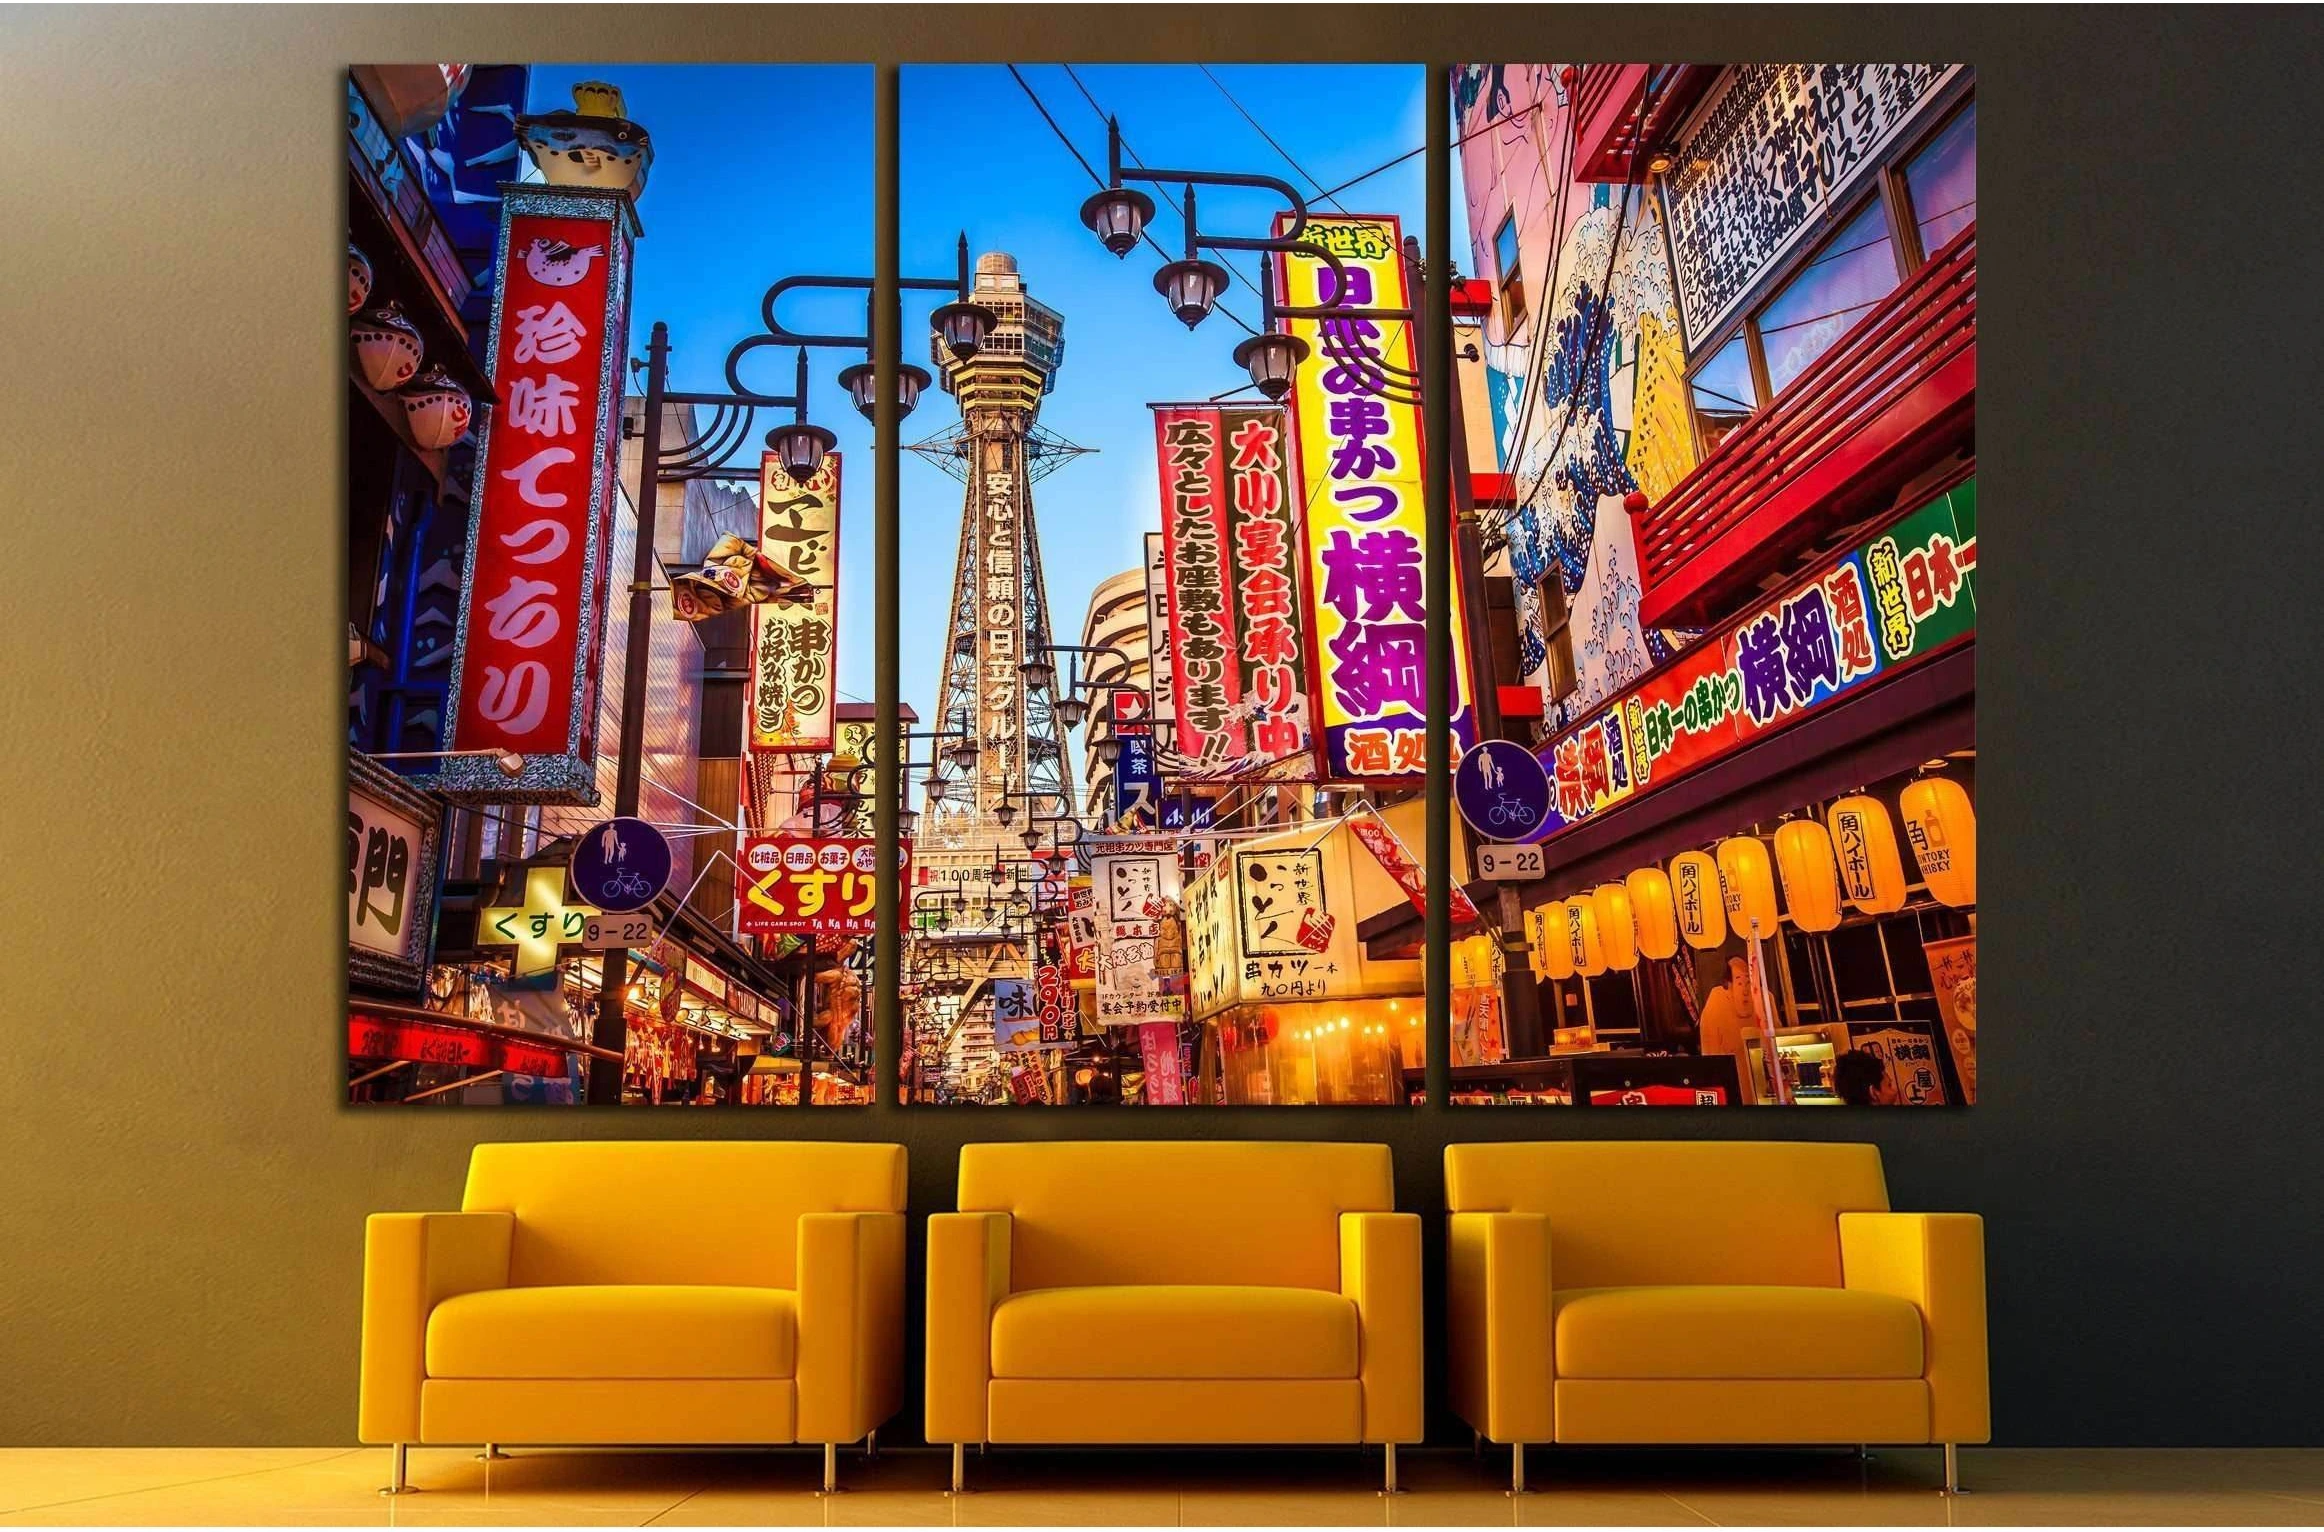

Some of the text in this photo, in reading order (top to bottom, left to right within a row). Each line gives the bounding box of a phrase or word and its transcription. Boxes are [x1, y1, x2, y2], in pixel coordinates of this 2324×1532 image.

[758, 618, 787, 729] お好み焼き
[788, 617, 828, 712] 串かつ
[1738, 587, 1838, 724] 横綱
[1130, 739, 1148, 775] 喫茶
[750, 851, 849, 865] 化粧品 日用品 お菓子
[1839, 814, 1871, 898] 角ハイボール
[495, 911, 585, 940] くすり
[1681, 864, 1700, 933] 角ハイボール
[1568, 908, 1584, 965] 角ハイボール
[1101, 999, 1182, 1015] 宴会予約受付中
